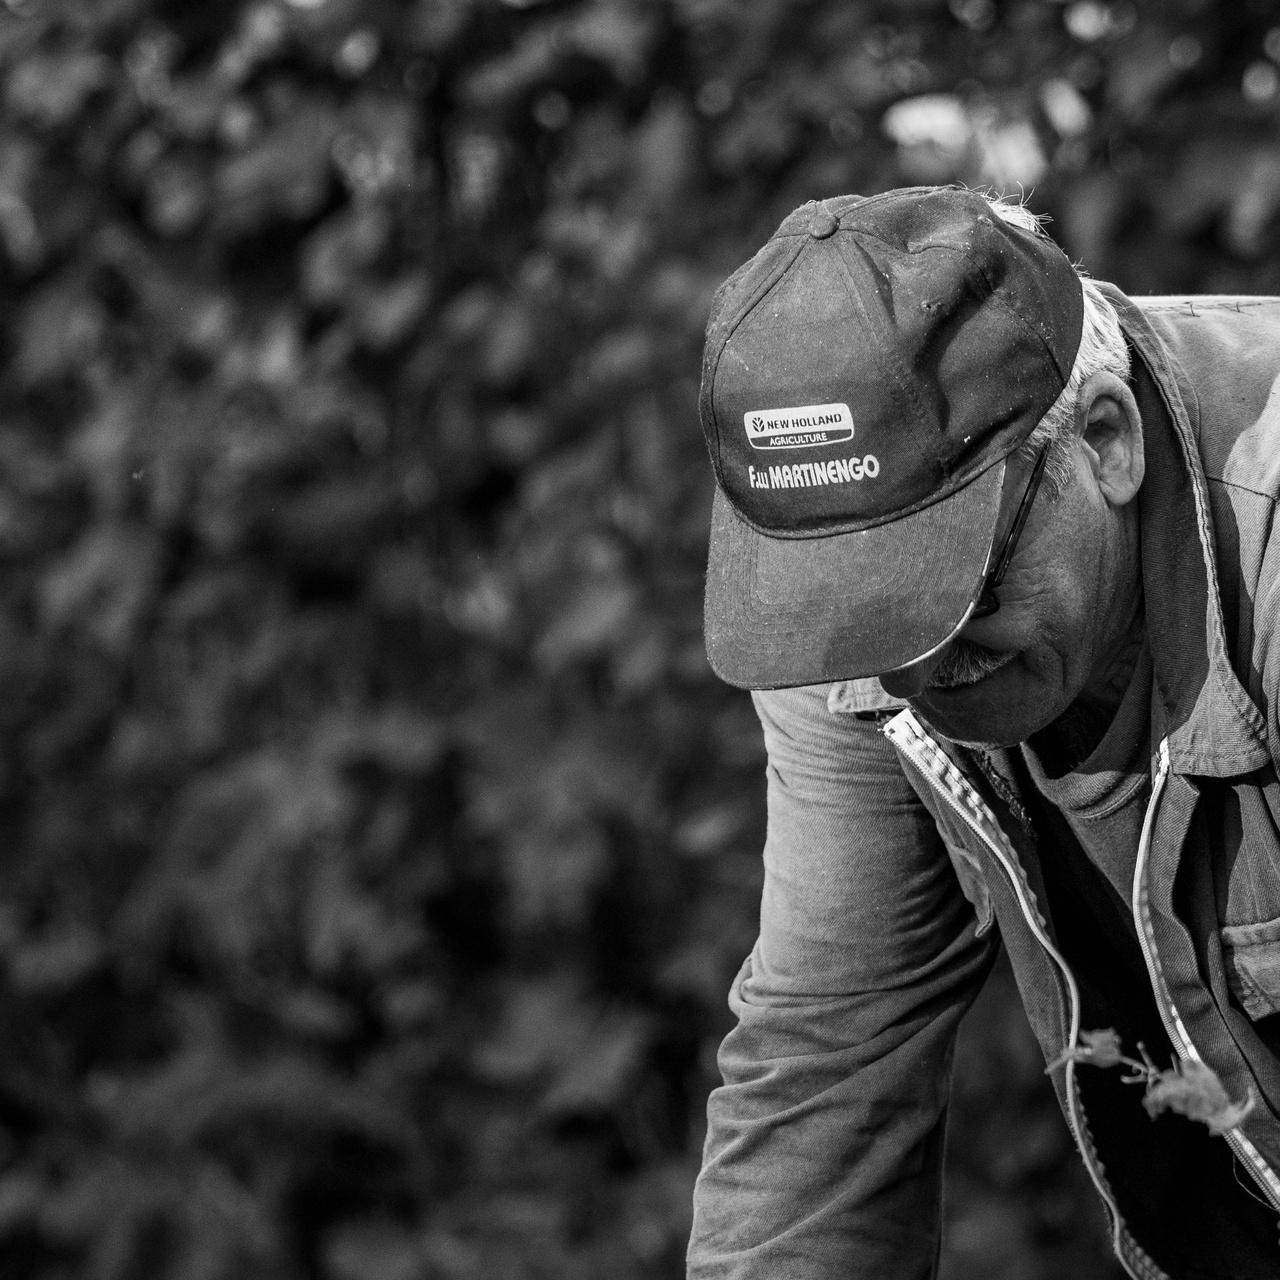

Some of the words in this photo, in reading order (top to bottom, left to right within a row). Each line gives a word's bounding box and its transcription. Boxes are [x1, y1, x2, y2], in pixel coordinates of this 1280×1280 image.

[767, 419, 789, 430] NEW
[792, 413, 842, 428] HOLLAND
[769, 432, 828, 446] AGRICULTURE
[769, 454, 880, 489] MARTINENGO
